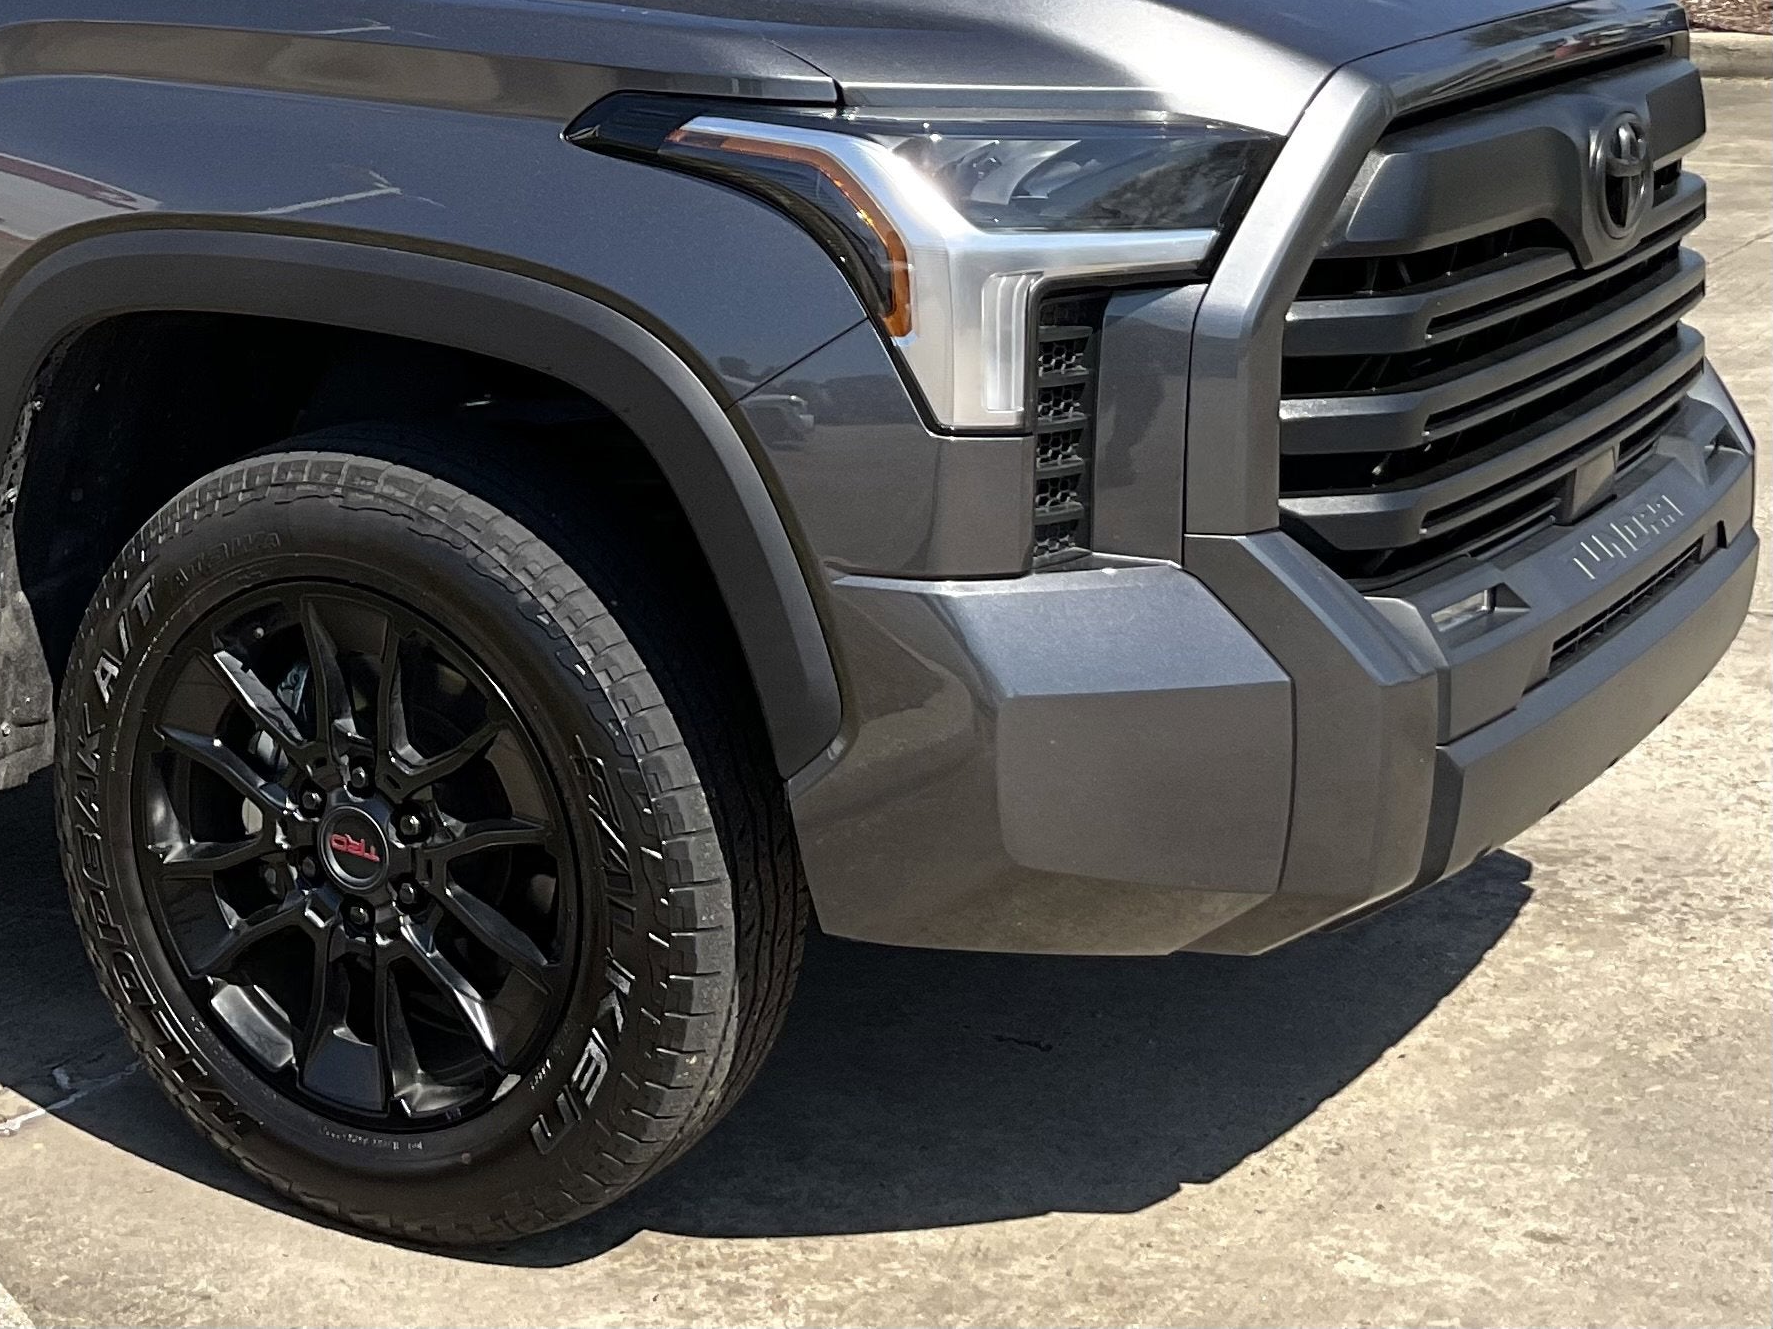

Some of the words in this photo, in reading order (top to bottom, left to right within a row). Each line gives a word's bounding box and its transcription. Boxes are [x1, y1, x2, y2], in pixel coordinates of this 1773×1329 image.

[1566, 494, 1684, 581] TUNDRA
[93, 573, 156, 710] A/T
[330, 833, 381, 863] TRD
